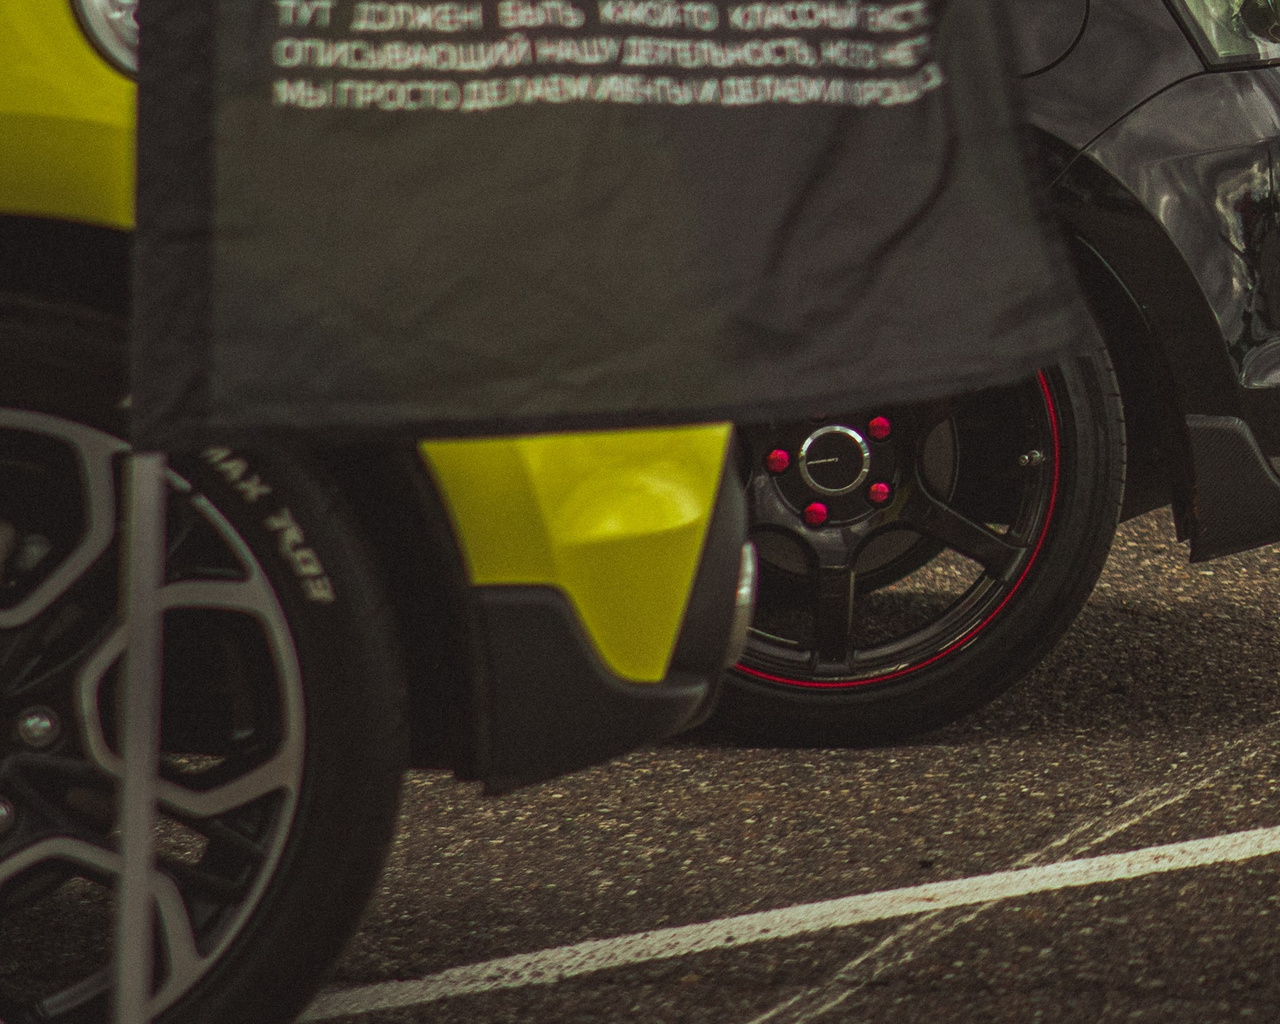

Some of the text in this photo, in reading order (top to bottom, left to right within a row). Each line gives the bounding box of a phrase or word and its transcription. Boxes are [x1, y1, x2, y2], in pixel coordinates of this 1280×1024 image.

[350, 0, 483, 32] ДОЛЖЕН
[272, 32, 532, 71] ОПИСЫВАЮЩИЙ
[534, 37, 620, 65] НАШУ
[273, 78, 332, 108] МЫ
[334, 78, 460, 110] ПРОСТО
[459, 74, 592, 112] ДЕЛАЕМ
[720, 75, 826, 107] ДЕЛАЕМ
